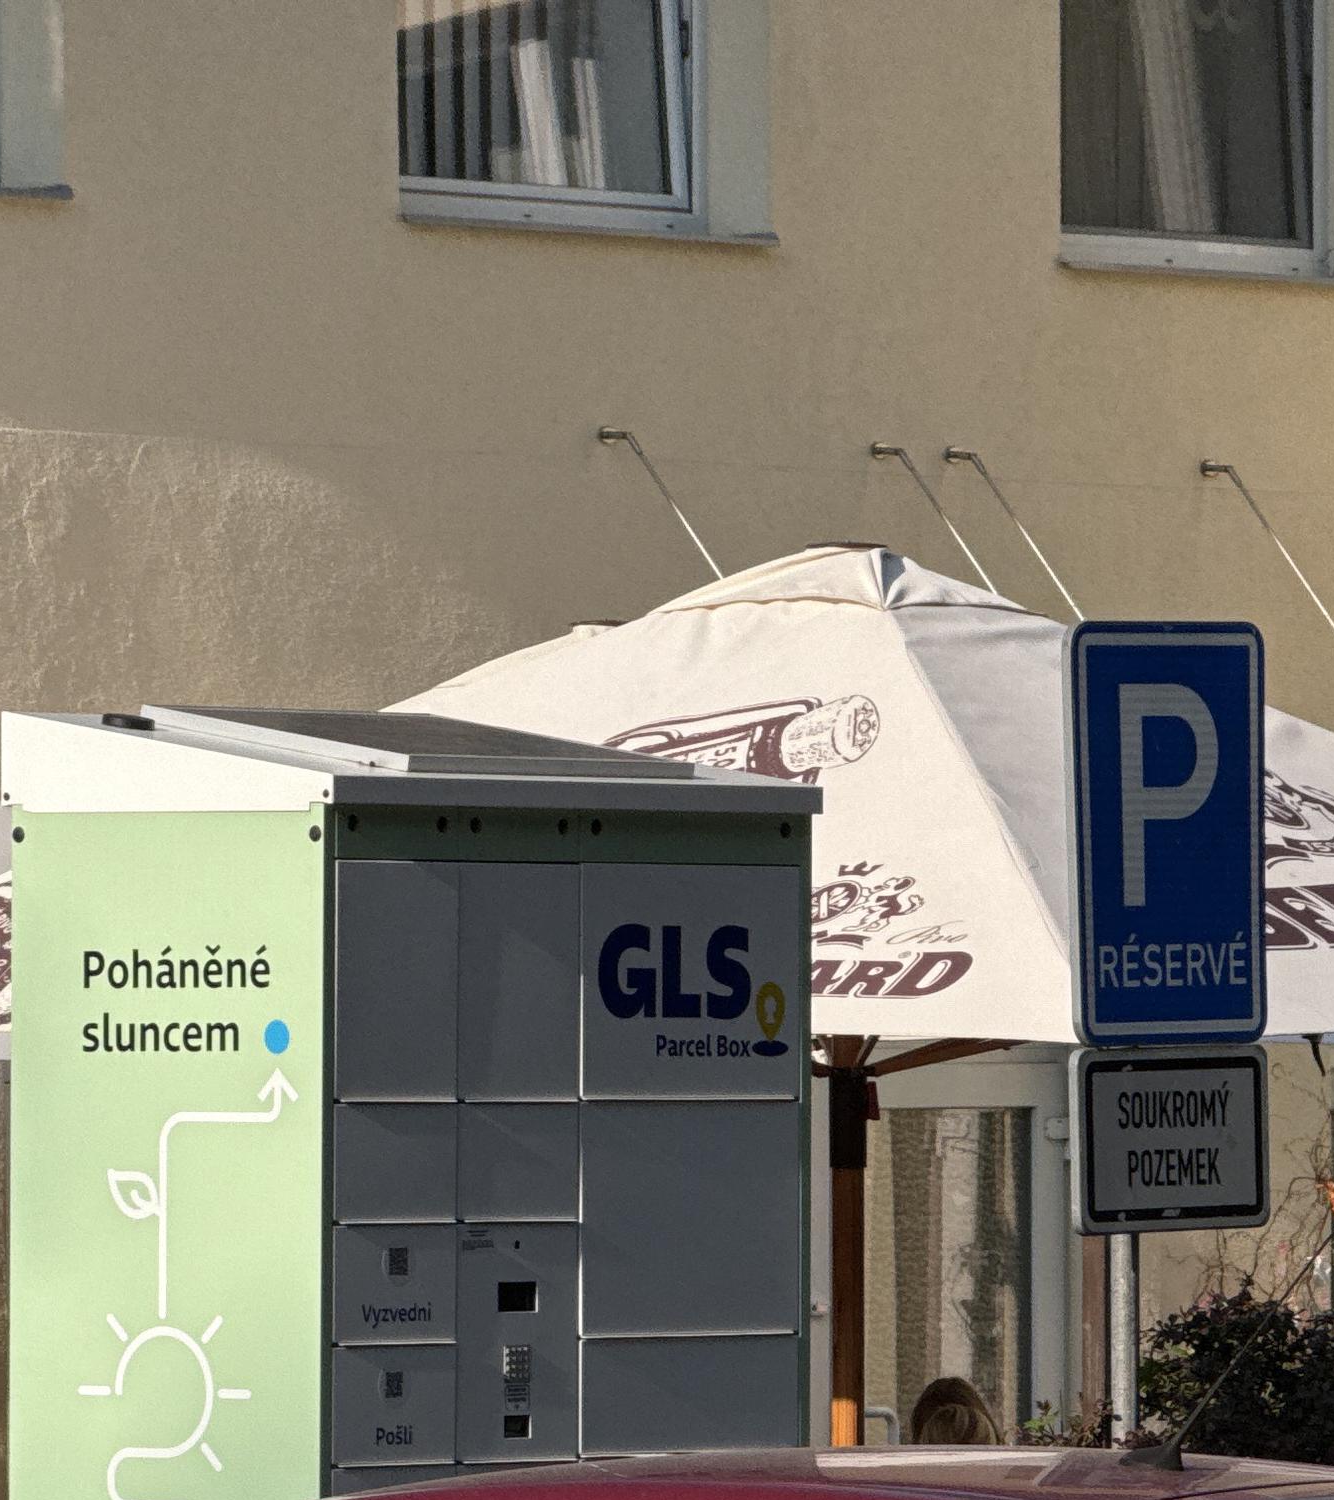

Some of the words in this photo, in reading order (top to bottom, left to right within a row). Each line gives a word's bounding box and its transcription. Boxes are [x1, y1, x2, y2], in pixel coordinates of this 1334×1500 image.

[1118, 682, 1219, 907] P
[886, 919, 969, 945] Pivo
[83, 944, 271, 988] Poháněné
[597, 923, 752, 1020] GLS
[1099, 930, 1248, 988] RÉSERVÉ
[82, 1012, 240, 1052] sluncem
[655, 1034, 713, 1057] Parcel
[716, 1034, 751, 1057] Box
[1117, 1081, 1229, 1129] SOUKROMÝ
[1128, 1148, 1221, 1188] POZEMEK
[361, 1302, 432, 1329] Vyzvedni
[375, 1425, 413, 1446] Pošli
